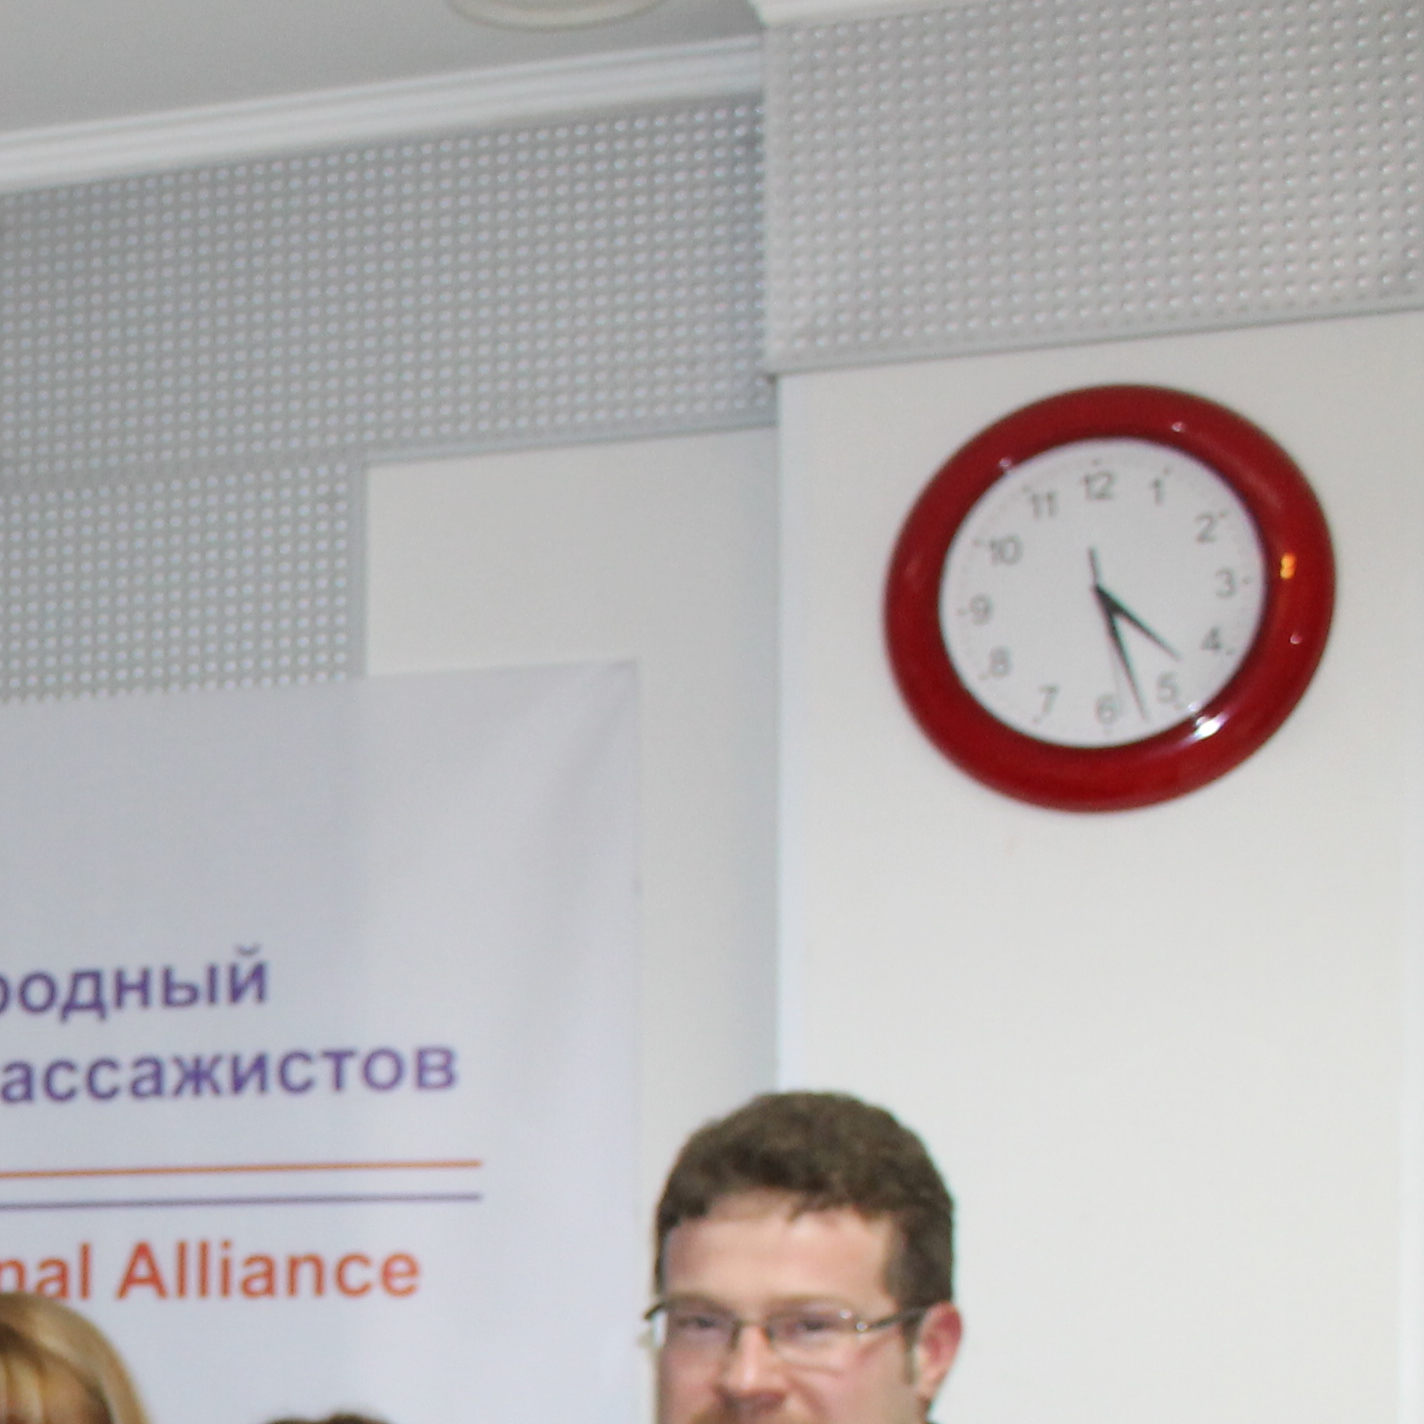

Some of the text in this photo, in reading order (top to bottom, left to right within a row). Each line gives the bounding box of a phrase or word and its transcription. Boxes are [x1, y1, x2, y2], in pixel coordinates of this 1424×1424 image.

[1082, 470, 1117, 501] 12
[1029, 490, 1057, 520] 11
[1194, 511, 1218, 543] 2
[988, 534, 1023, 566] 10
[1215, 566, 1237, 599] 3
[968, 593, 994, 626] 9
[1201, 625, 1224, 654] 4
[988, 645, 1013, 679] 8
[1038, 683, 1061, 716] 7
[1155, 670, 1181, 705] 5
[1094, 693, 1121, 726] 6
[117, 1239, 422, 1301] Alliance
